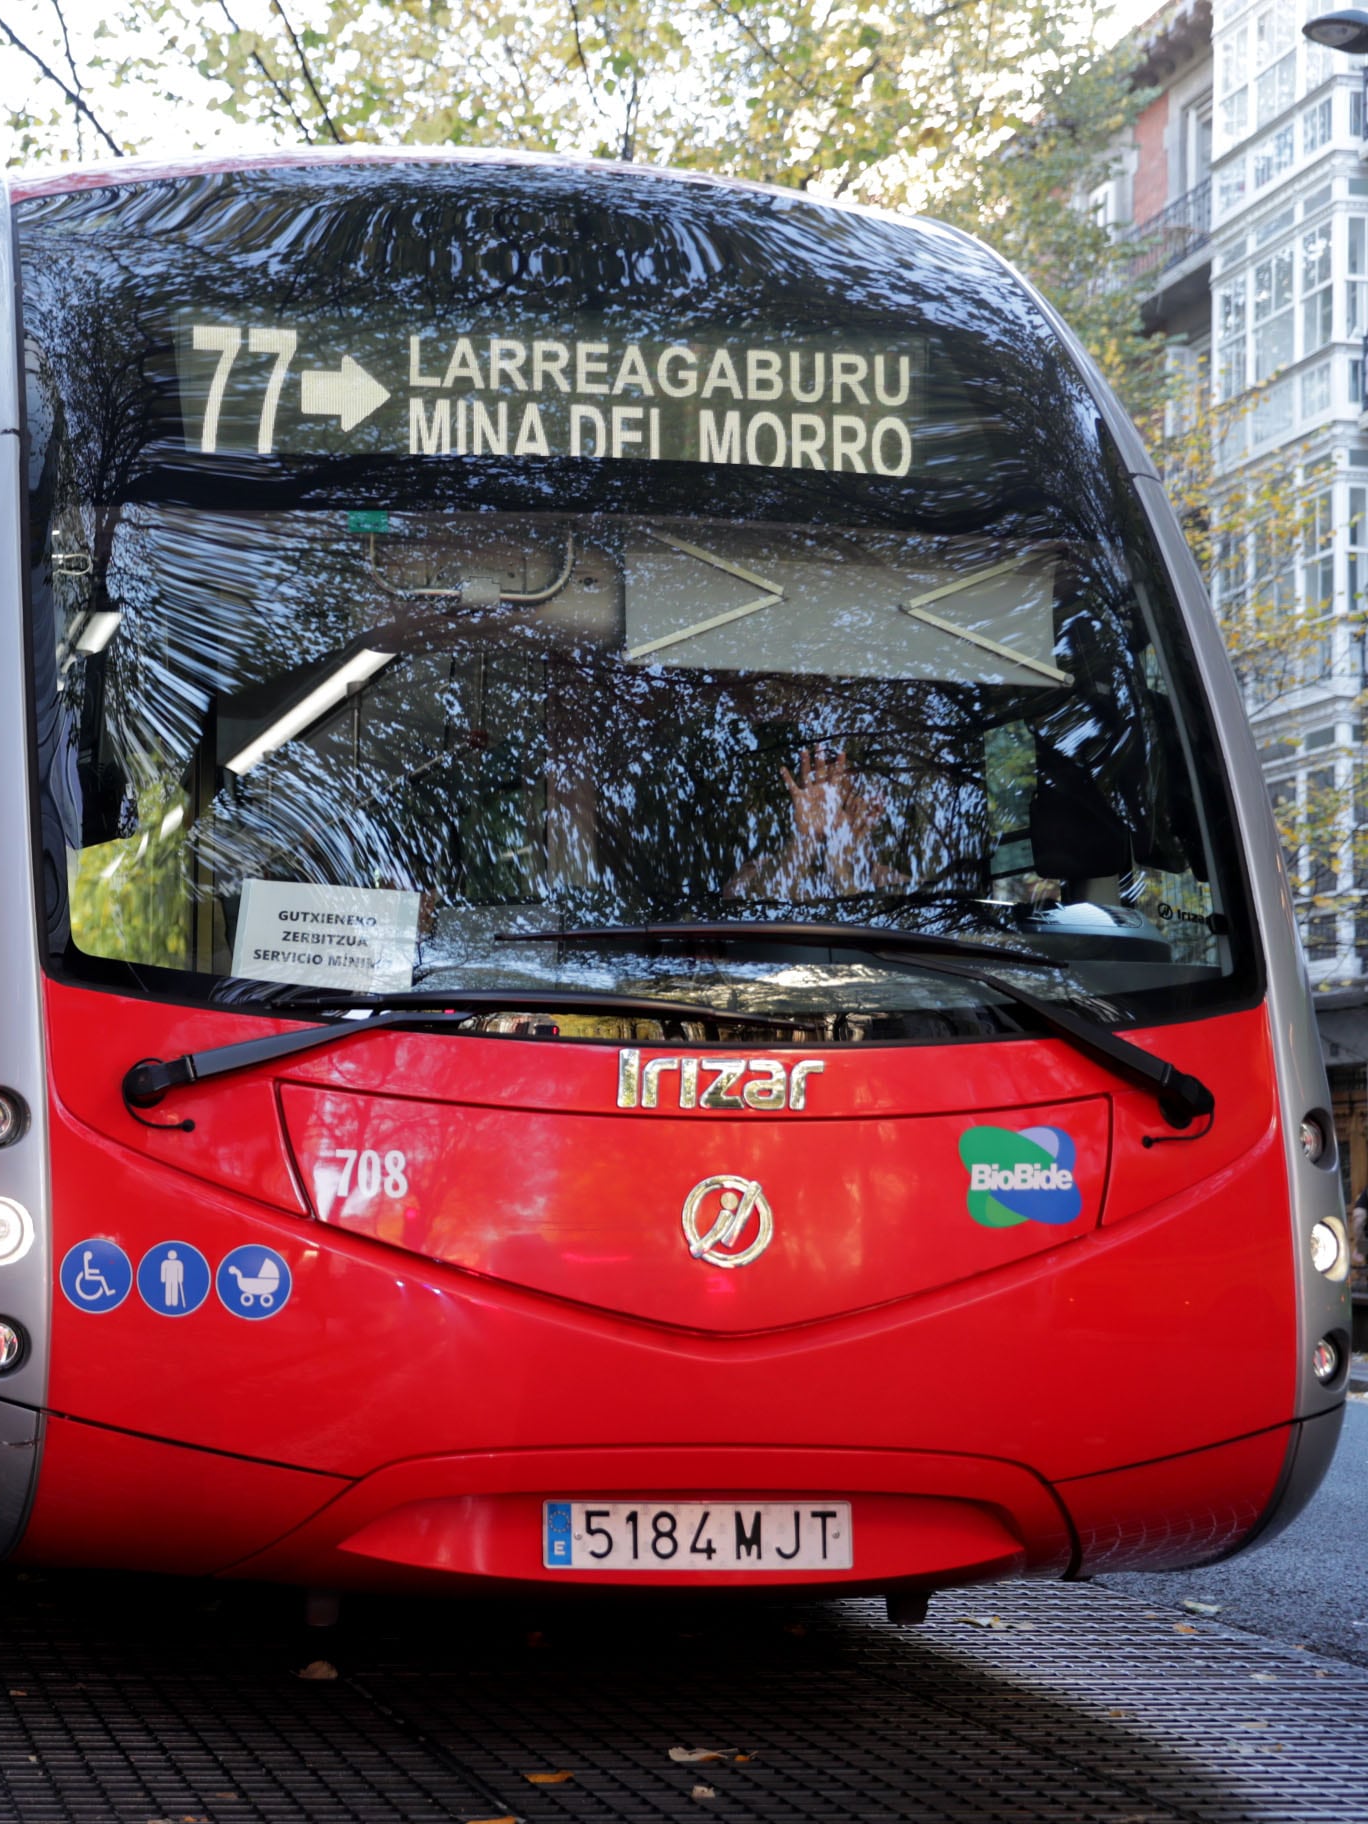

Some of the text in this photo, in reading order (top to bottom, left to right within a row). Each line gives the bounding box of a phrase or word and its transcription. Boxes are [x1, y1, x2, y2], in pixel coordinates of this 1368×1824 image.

[192, 325, 297, 454] 77
[408, 336, 910, 406] LARREAGABURU
[408, 399, 550, 457] MINA
[699, 409, 912, 477] MORRO
[278, 910, 377, 927] GUTXIENEKO
[282, 931, 368, 947] ZERBITZUA
[253, 949, 393, 971] SERVICIO MÍNIM
[617, 1049, 825, 1110] Irizar
[335, 1149, 408, 1198] 708
[970, 1163, 1073, 1191] BioBide
[554, 1511, 837, 1560] E 5184 MJT
